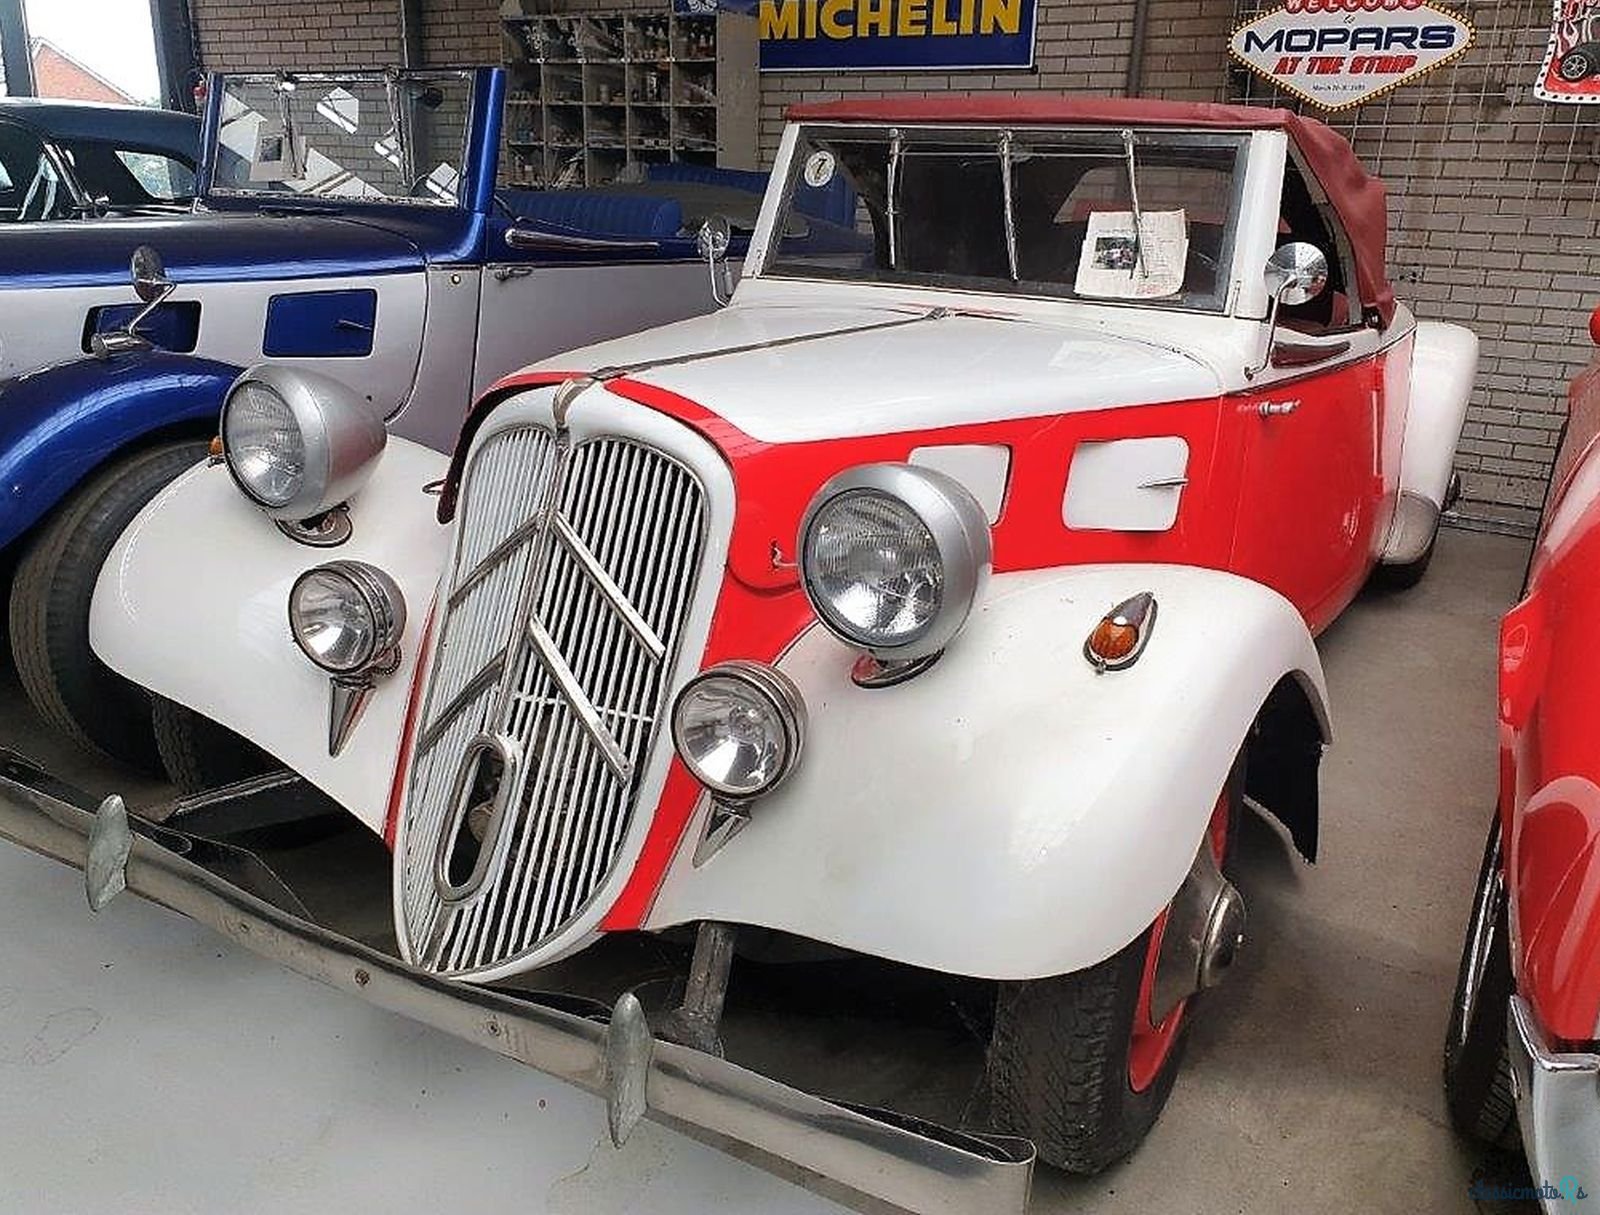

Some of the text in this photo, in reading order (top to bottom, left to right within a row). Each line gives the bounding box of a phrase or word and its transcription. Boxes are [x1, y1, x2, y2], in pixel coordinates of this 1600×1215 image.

[759, 0, 1021, 40] MICHELIN
[1244, 25, 1457, 53] MOPARS
[1273, 55, 1418, 75] AT THE STRIP
